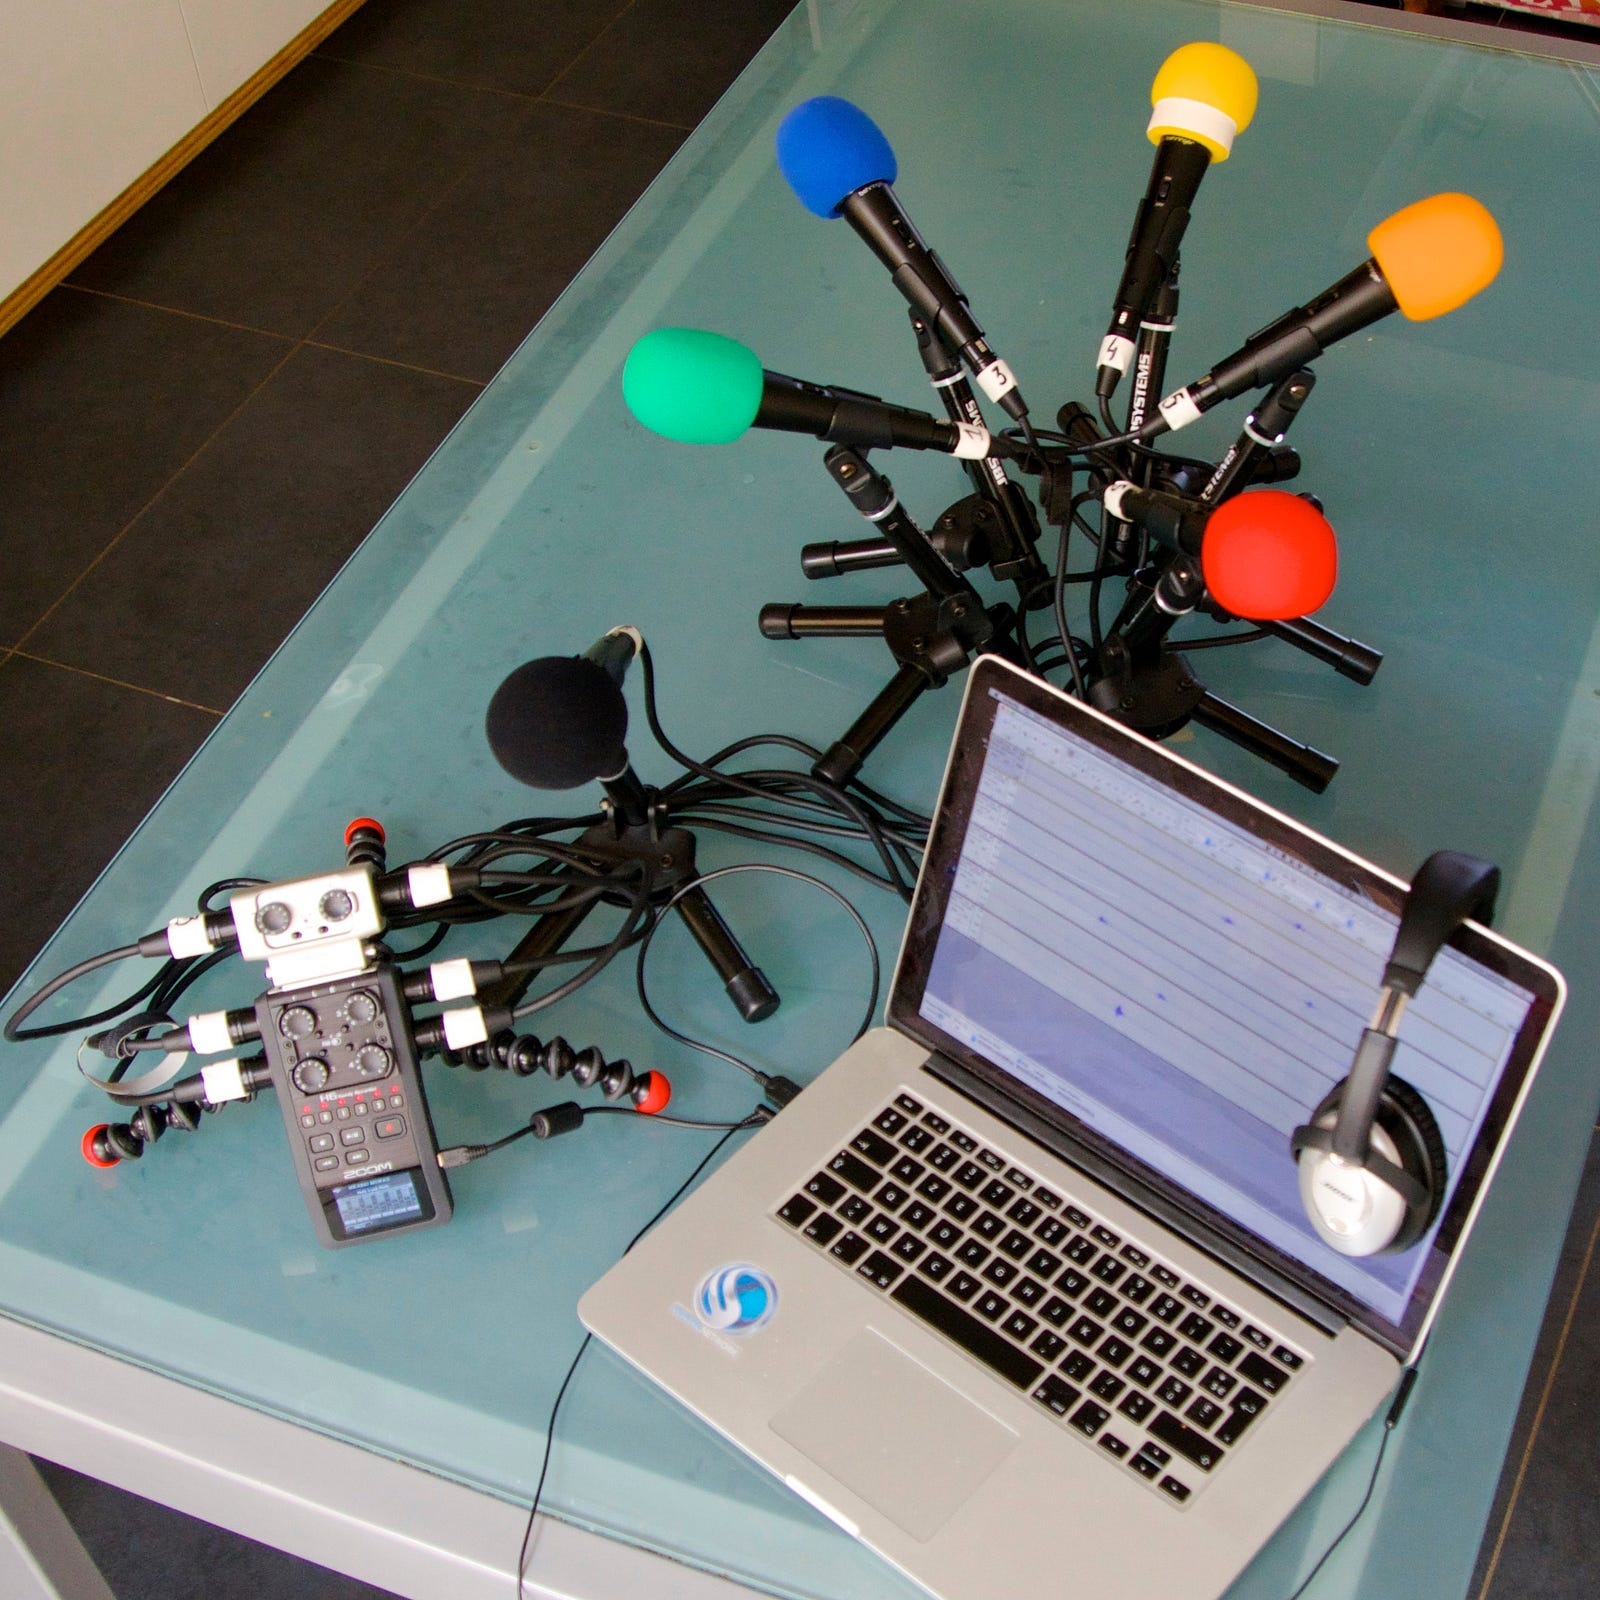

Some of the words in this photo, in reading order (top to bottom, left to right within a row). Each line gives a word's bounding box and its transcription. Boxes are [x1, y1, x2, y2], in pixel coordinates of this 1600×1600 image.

[1106, 336, 1118, 361] 4
[991, 364, 1008, 386] 3
[1130, 353, 1150, 445] SYSTEMS
[1162, 391, 1185, 410] 5
[965, 399, 1009, 486] JBSMS
[343, 1162, 392, 1179] ZOOM
